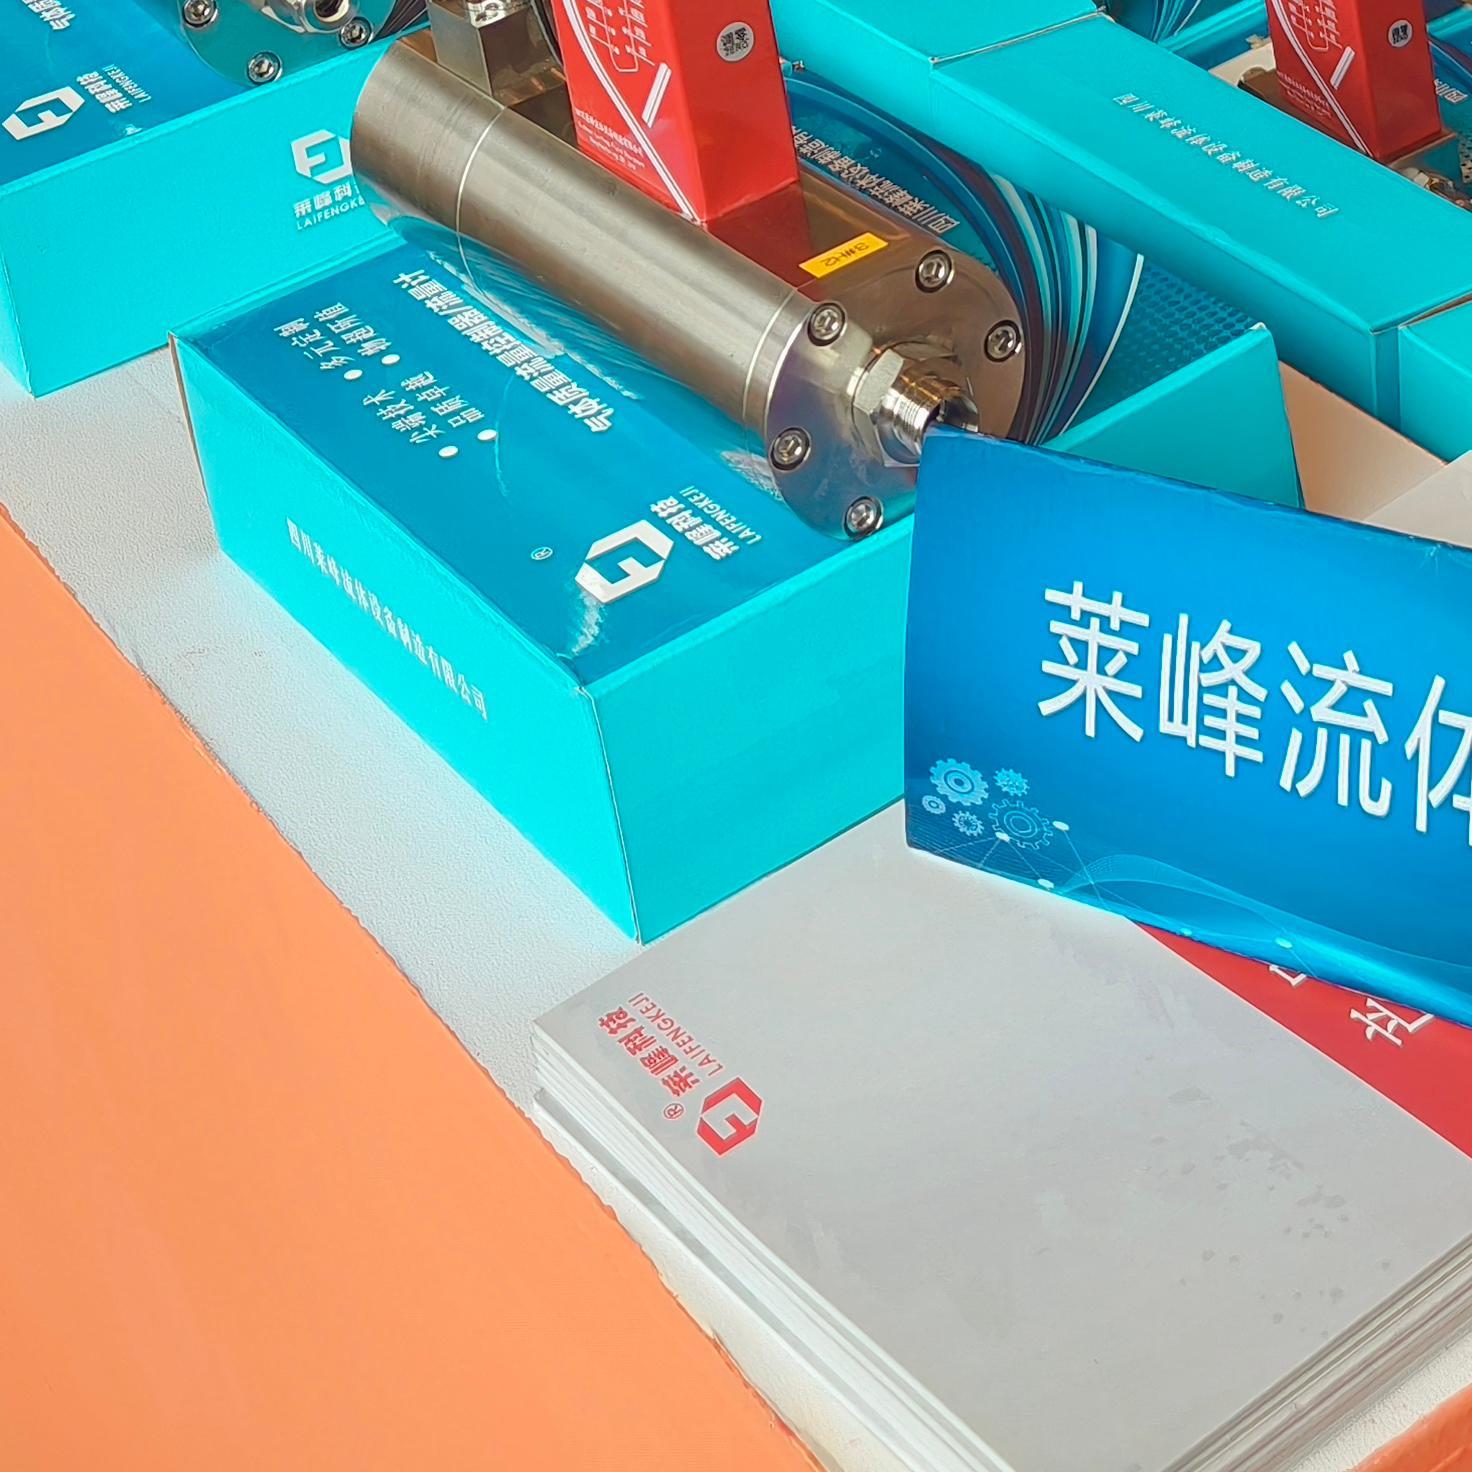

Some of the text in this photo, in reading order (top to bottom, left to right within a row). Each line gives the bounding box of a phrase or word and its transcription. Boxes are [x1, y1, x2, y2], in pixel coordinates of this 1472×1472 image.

[273, 312, 443, 449] 尖端技术 多元定制
[312, 297, 485, 431] 品质卓越 物超所值
[394, 261, 621, 436] 气体质量流量控制器/流量计
[650, 490, 741, 563] 莱峰科技
[681, 480, 762, 549] LAIFENGKEJI
[285, 516, 489, 722] 四川莱峰流体设备制造有限公司
[601, 1003, 704, 1099] 莱峰科技
[629, 990, 723, 1075] LAIFENGKEJI
